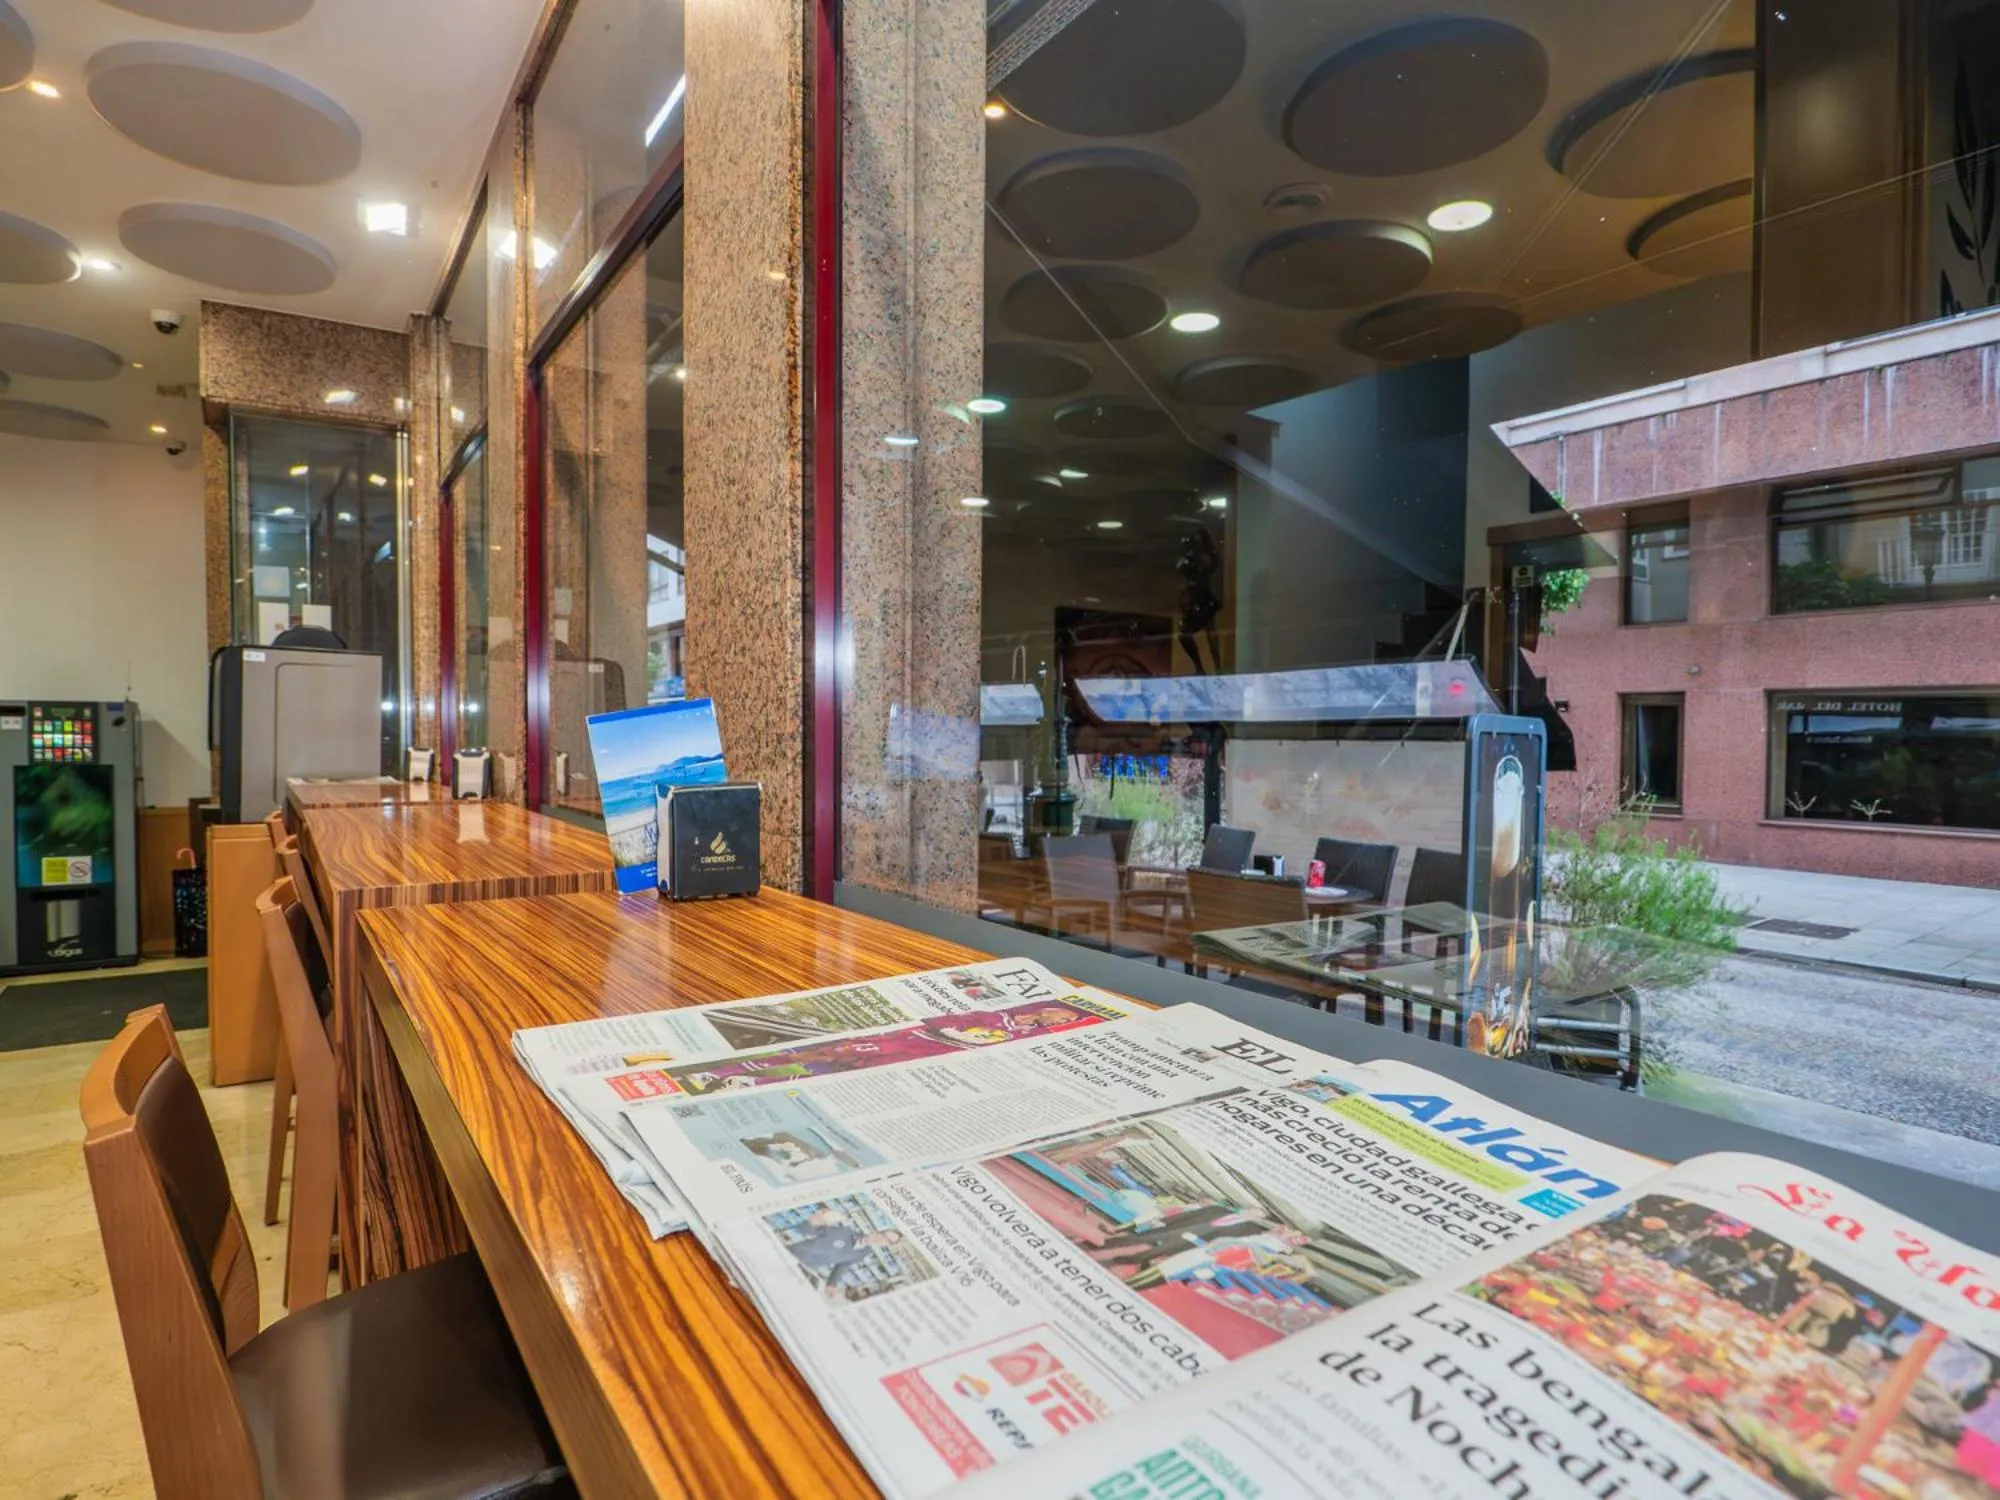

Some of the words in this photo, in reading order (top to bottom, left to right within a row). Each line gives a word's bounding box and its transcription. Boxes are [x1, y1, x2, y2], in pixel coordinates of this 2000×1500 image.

[1210, 1036, 1297, 1075] EL
[1284, 1118, 1369, 1165] creció
[1362, 1160, 1394, 1181] la
[1391, 1178, 1479, 1222] renta
[1306, 1152, 1345, 1175] en
[1342, 1172, 1402, 1205] una
[1313, 1115, 1412, 1167] ciudad
[1399, 1164, 1526, 1225] gallega
[1370, 1091, 1622, 1200] Atlán
[950, 1165, 987, 1196] Vigo
[982, 1193, 1053, 1249] volverá
[1039, 1247, 1060, 1261] a
[1055, 1257, 1114, 1302] tener
[1106, 1299, 1155, 1335] dos
[1319, 1347, 1384, 1389] de
[1365, 1321, 1414, 1355] la
[1413, 1301, 1499, 1351] Las
[1507, 1346, 1729, 1500] bengal
